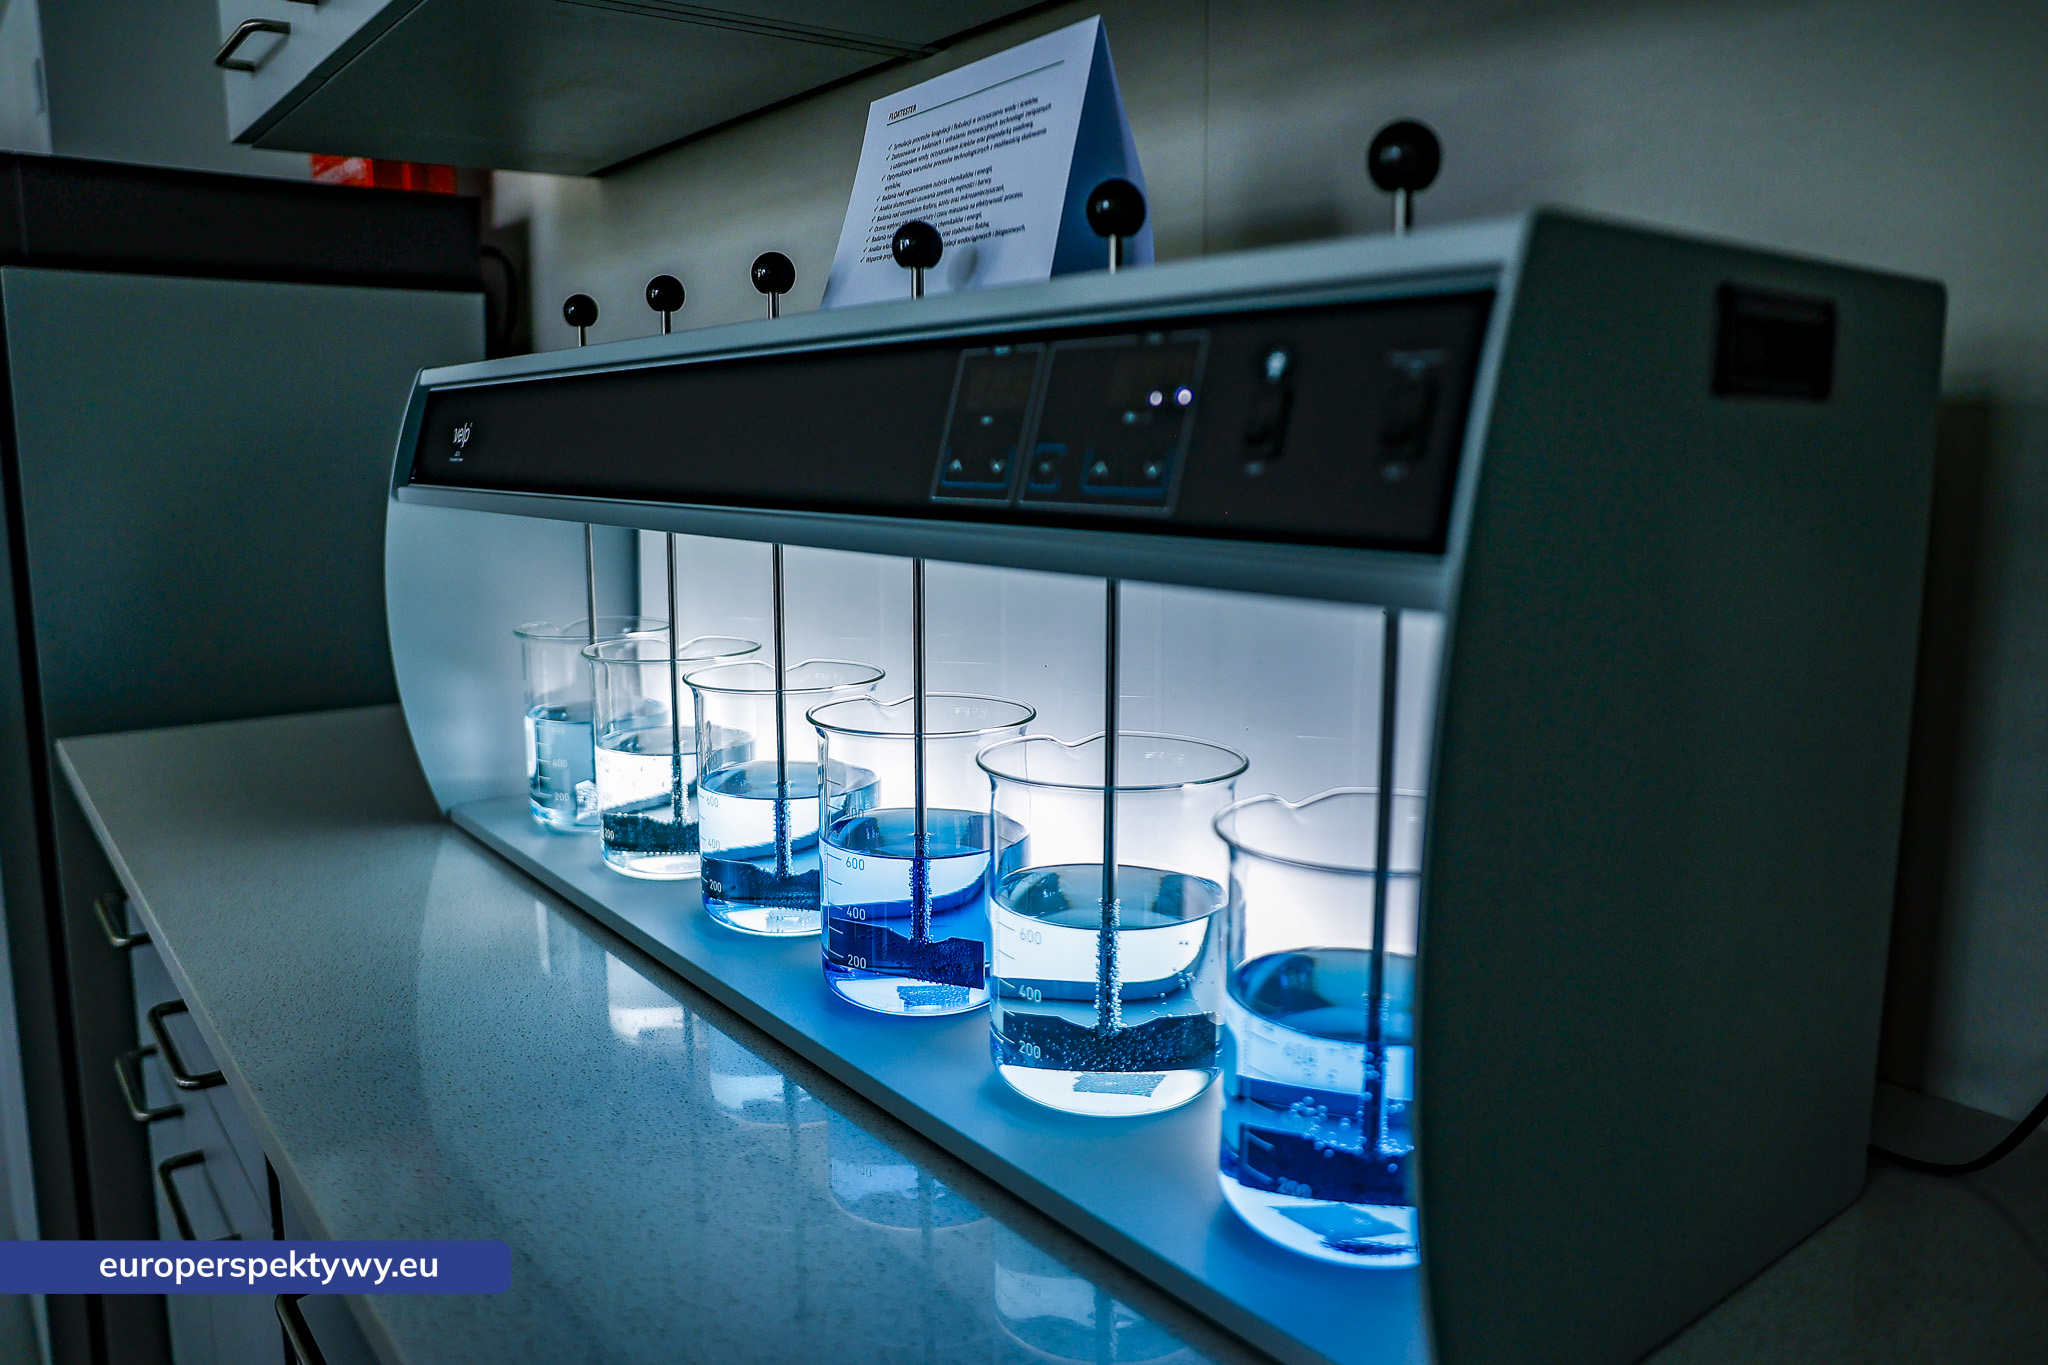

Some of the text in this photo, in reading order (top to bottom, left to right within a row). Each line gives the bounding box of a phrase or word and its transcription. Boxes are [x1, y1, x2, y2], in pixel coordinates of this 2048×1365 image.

[888, 104, 917, 121] FLOKTESTER
[552, 758, 568, 768] 400
[554, 792, 570, 801] 200
[706, 797, 719, 808] 600
[604, 828, 615, 840] 200
[708, 839, 721, 851] 400
[846, 857, 866, 871] 600
[709, 879, 722, 893] 200
[846, 906, 866, 921] 400
[1019, 928, 1043, 945] 600
[847, 954, 867, 969] 200
[1018, 984, 1042, 1003] 400
[1019, 1040, 1041, 1059] 200
